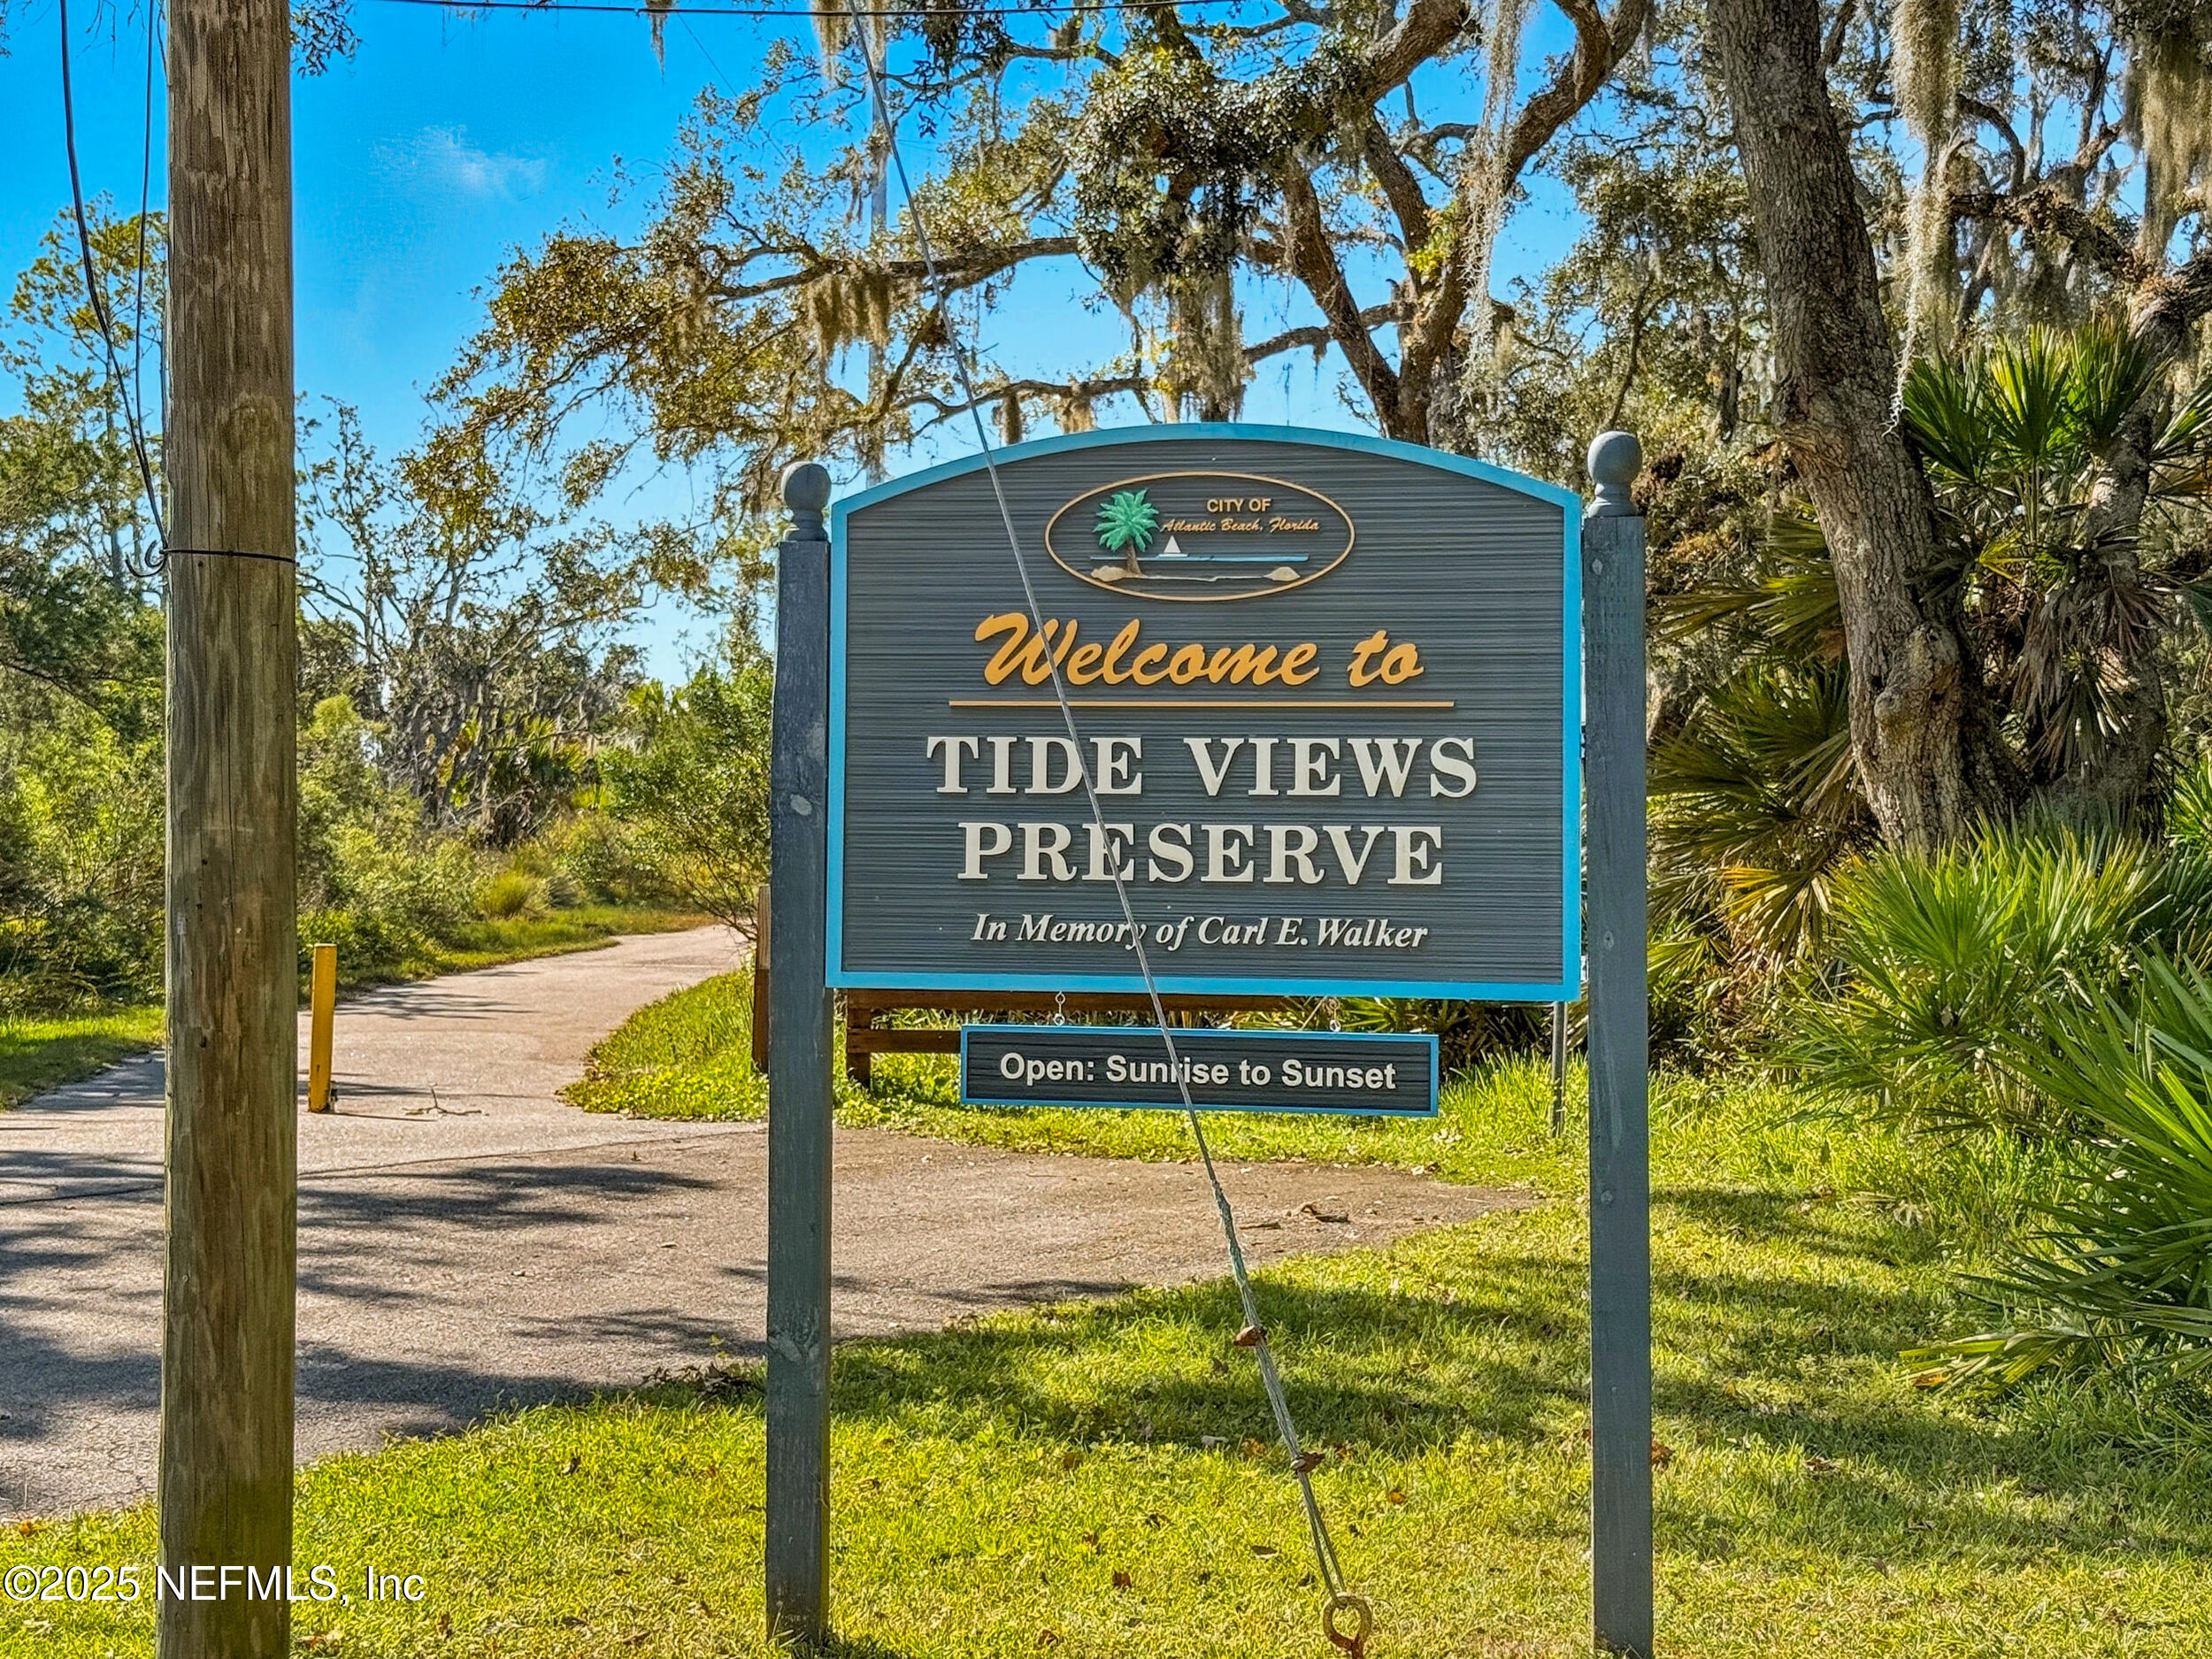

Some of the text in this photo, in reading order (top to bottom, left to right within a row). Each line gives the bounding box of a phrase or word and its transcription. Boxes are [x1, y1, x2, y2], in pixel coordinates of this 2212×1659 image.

[1207, 498, 1271, 512] CITY OF
[1160, 518, 1319, 534] Atlantic Beach, Florida
[975, 612, 1424, 687] Welcome to
[926, 736, 1478, 797] TIDE VIEWS
[956, 822, 1442, 885] PRESERVE
[971, 913, 1428, 951] In Memory of Carl E. Walker
[999, 1052, 1396, 1090] Open: Sunrise to Sunset
